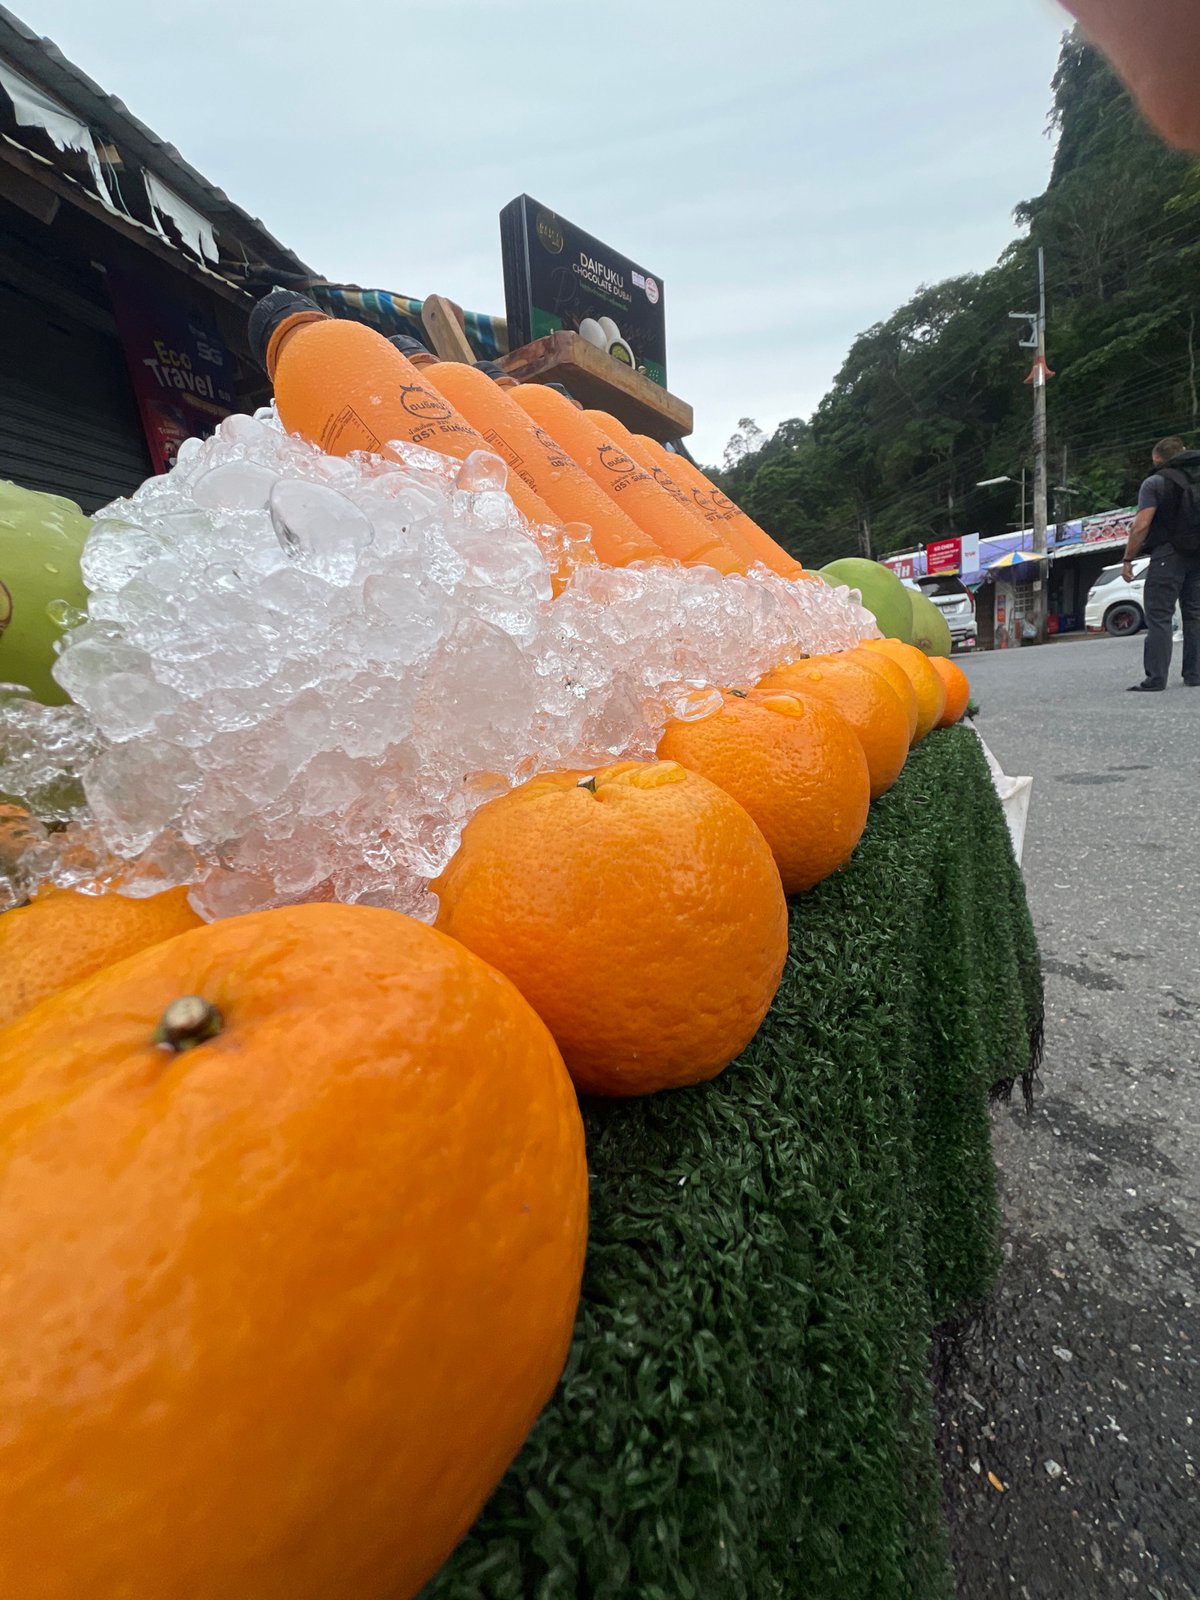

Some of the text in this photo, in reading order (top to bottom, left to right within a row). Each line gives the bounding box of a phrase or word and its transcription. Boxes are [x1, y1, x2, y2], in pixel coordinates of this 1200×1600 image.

[572, 263, 612, 292] CHOCOLATE
[613, 286, 632, 303] DUBAI
[580, 252, 624, 288] DAIFUKU
[153, 339, 192, 370] Eco
[197, 341, 223, 366] 5G
[143, 358, 214, 399] Travel
